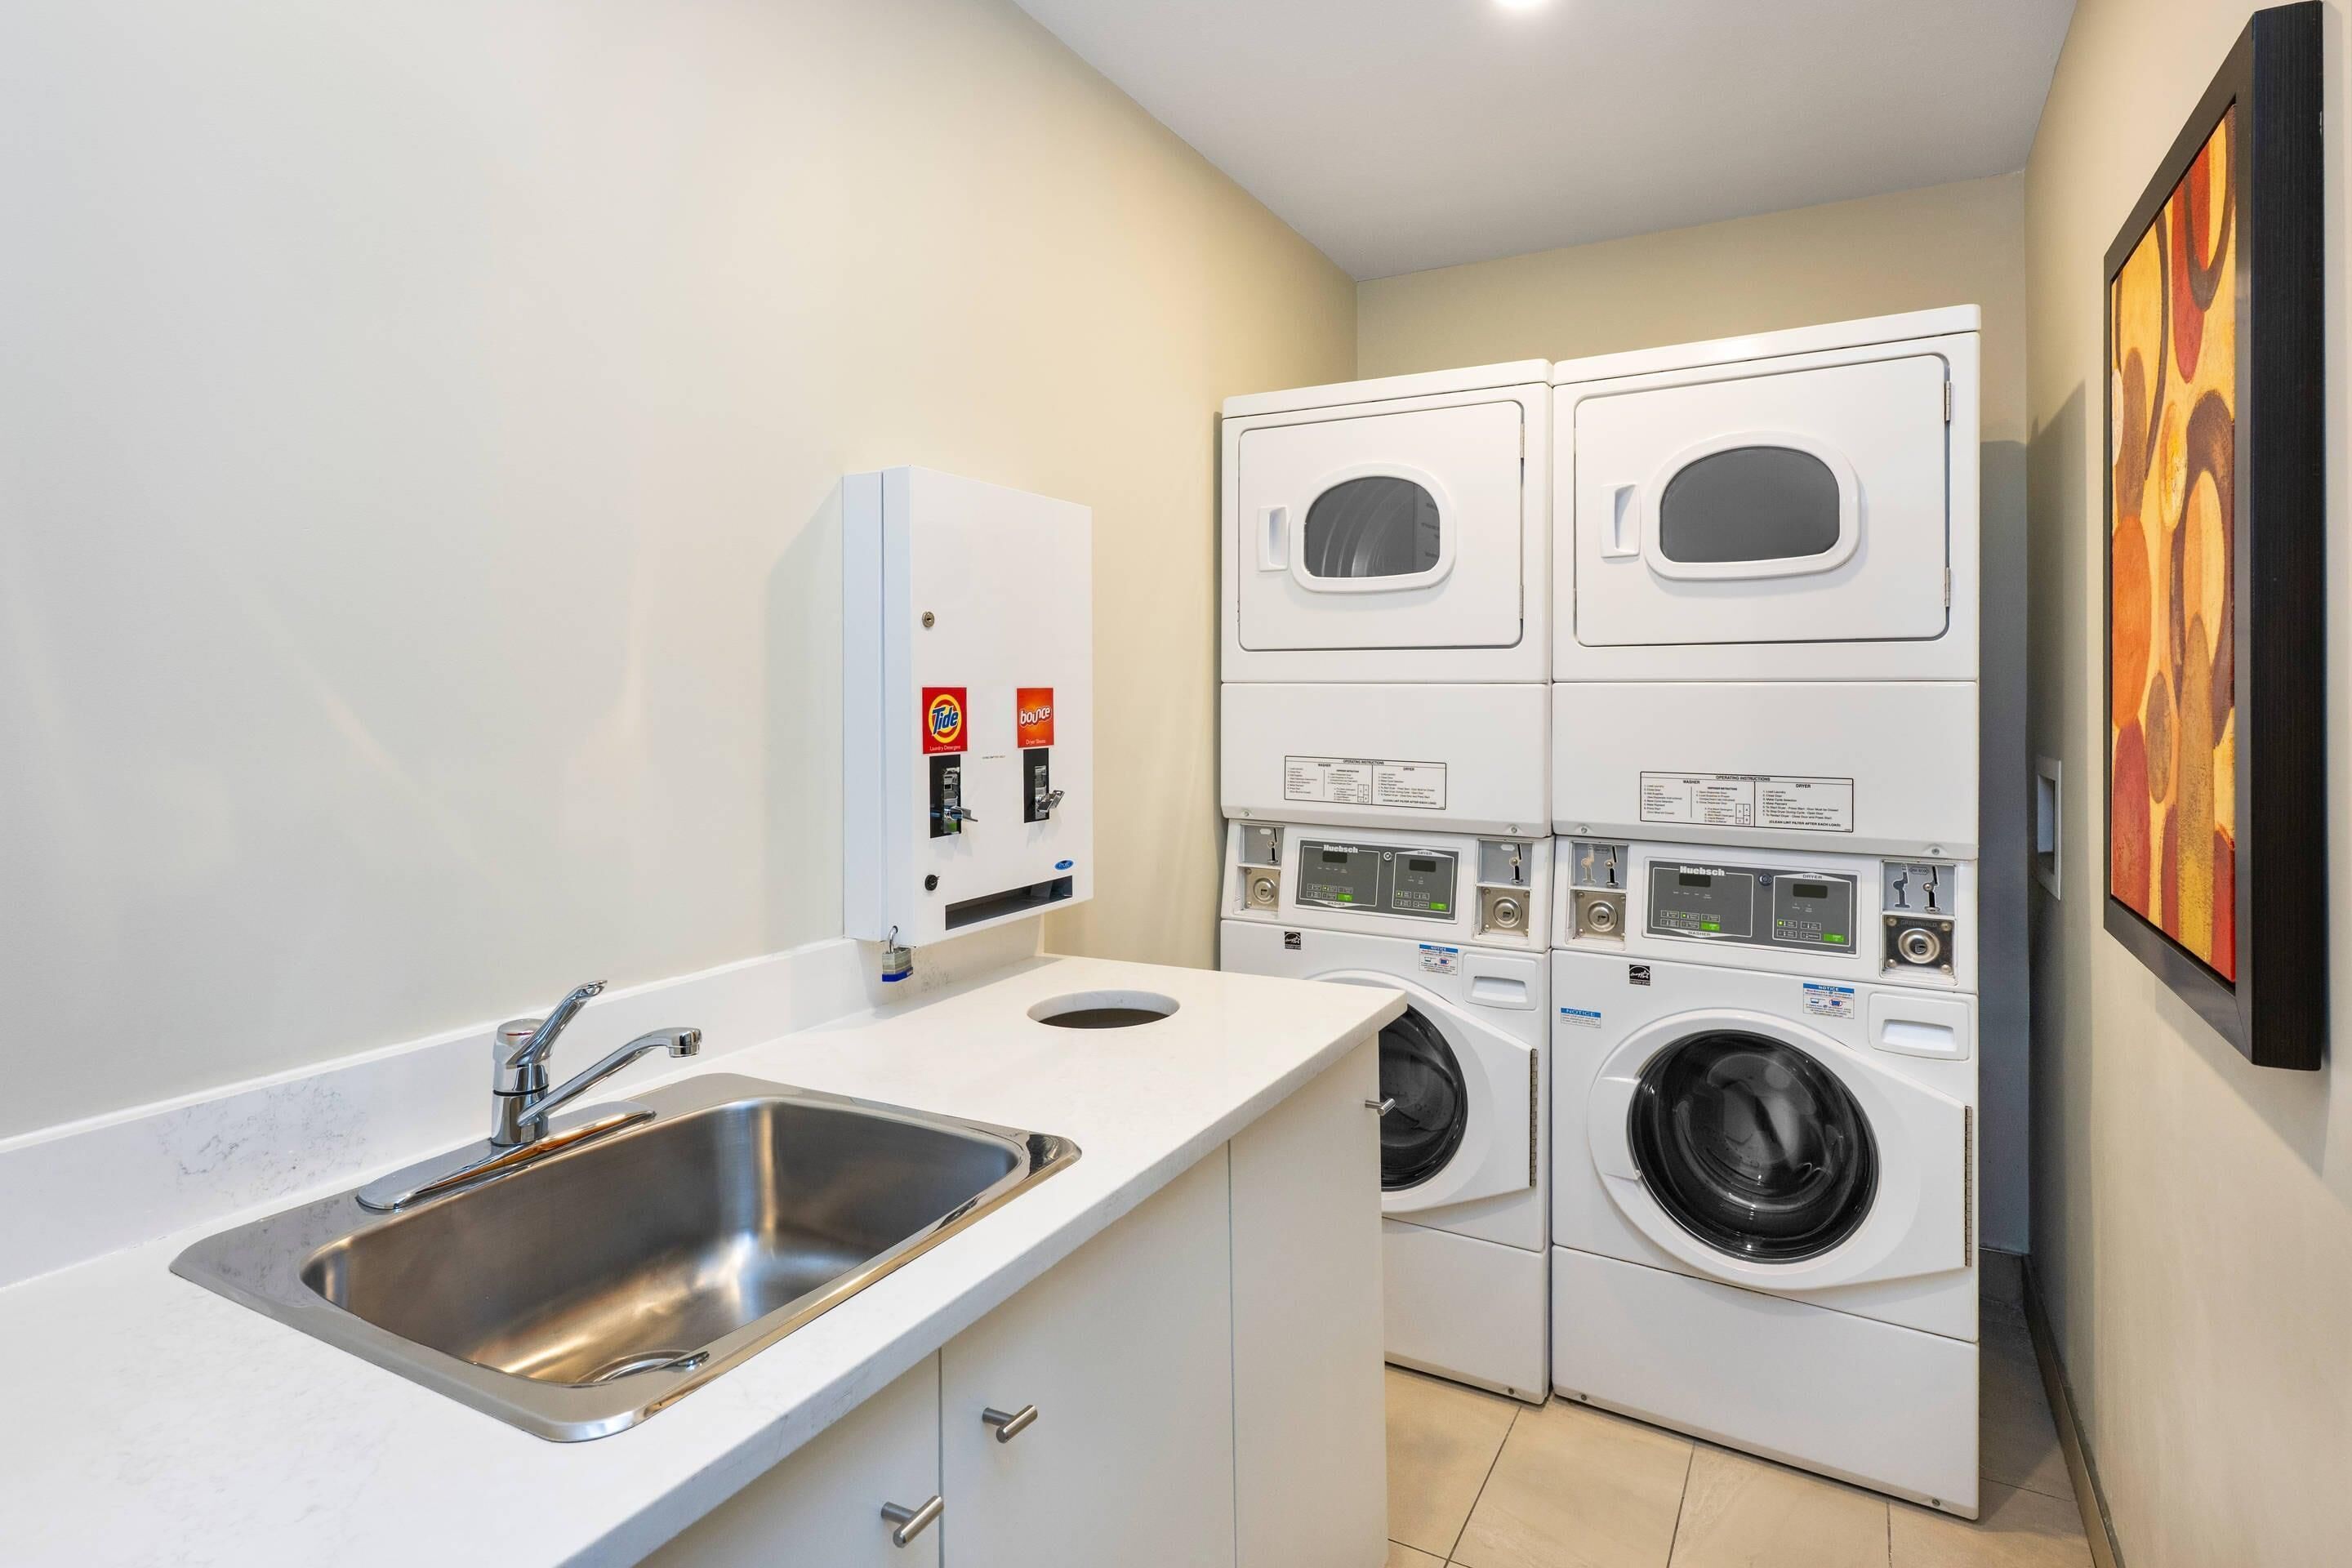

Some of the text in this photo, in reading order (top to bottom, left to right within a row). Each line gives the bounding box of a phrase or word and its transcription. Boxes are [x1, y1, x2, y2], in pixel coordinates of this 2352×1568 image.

[1021, 706, 1051, 725] bounce
[932, 706, 959, 736] Tide
[1323, 844, 1359, 853] Huebsch
[1680, 866, 1726, 875] Huebsch
[1900, 920, 1937, 928] GREENWALD
